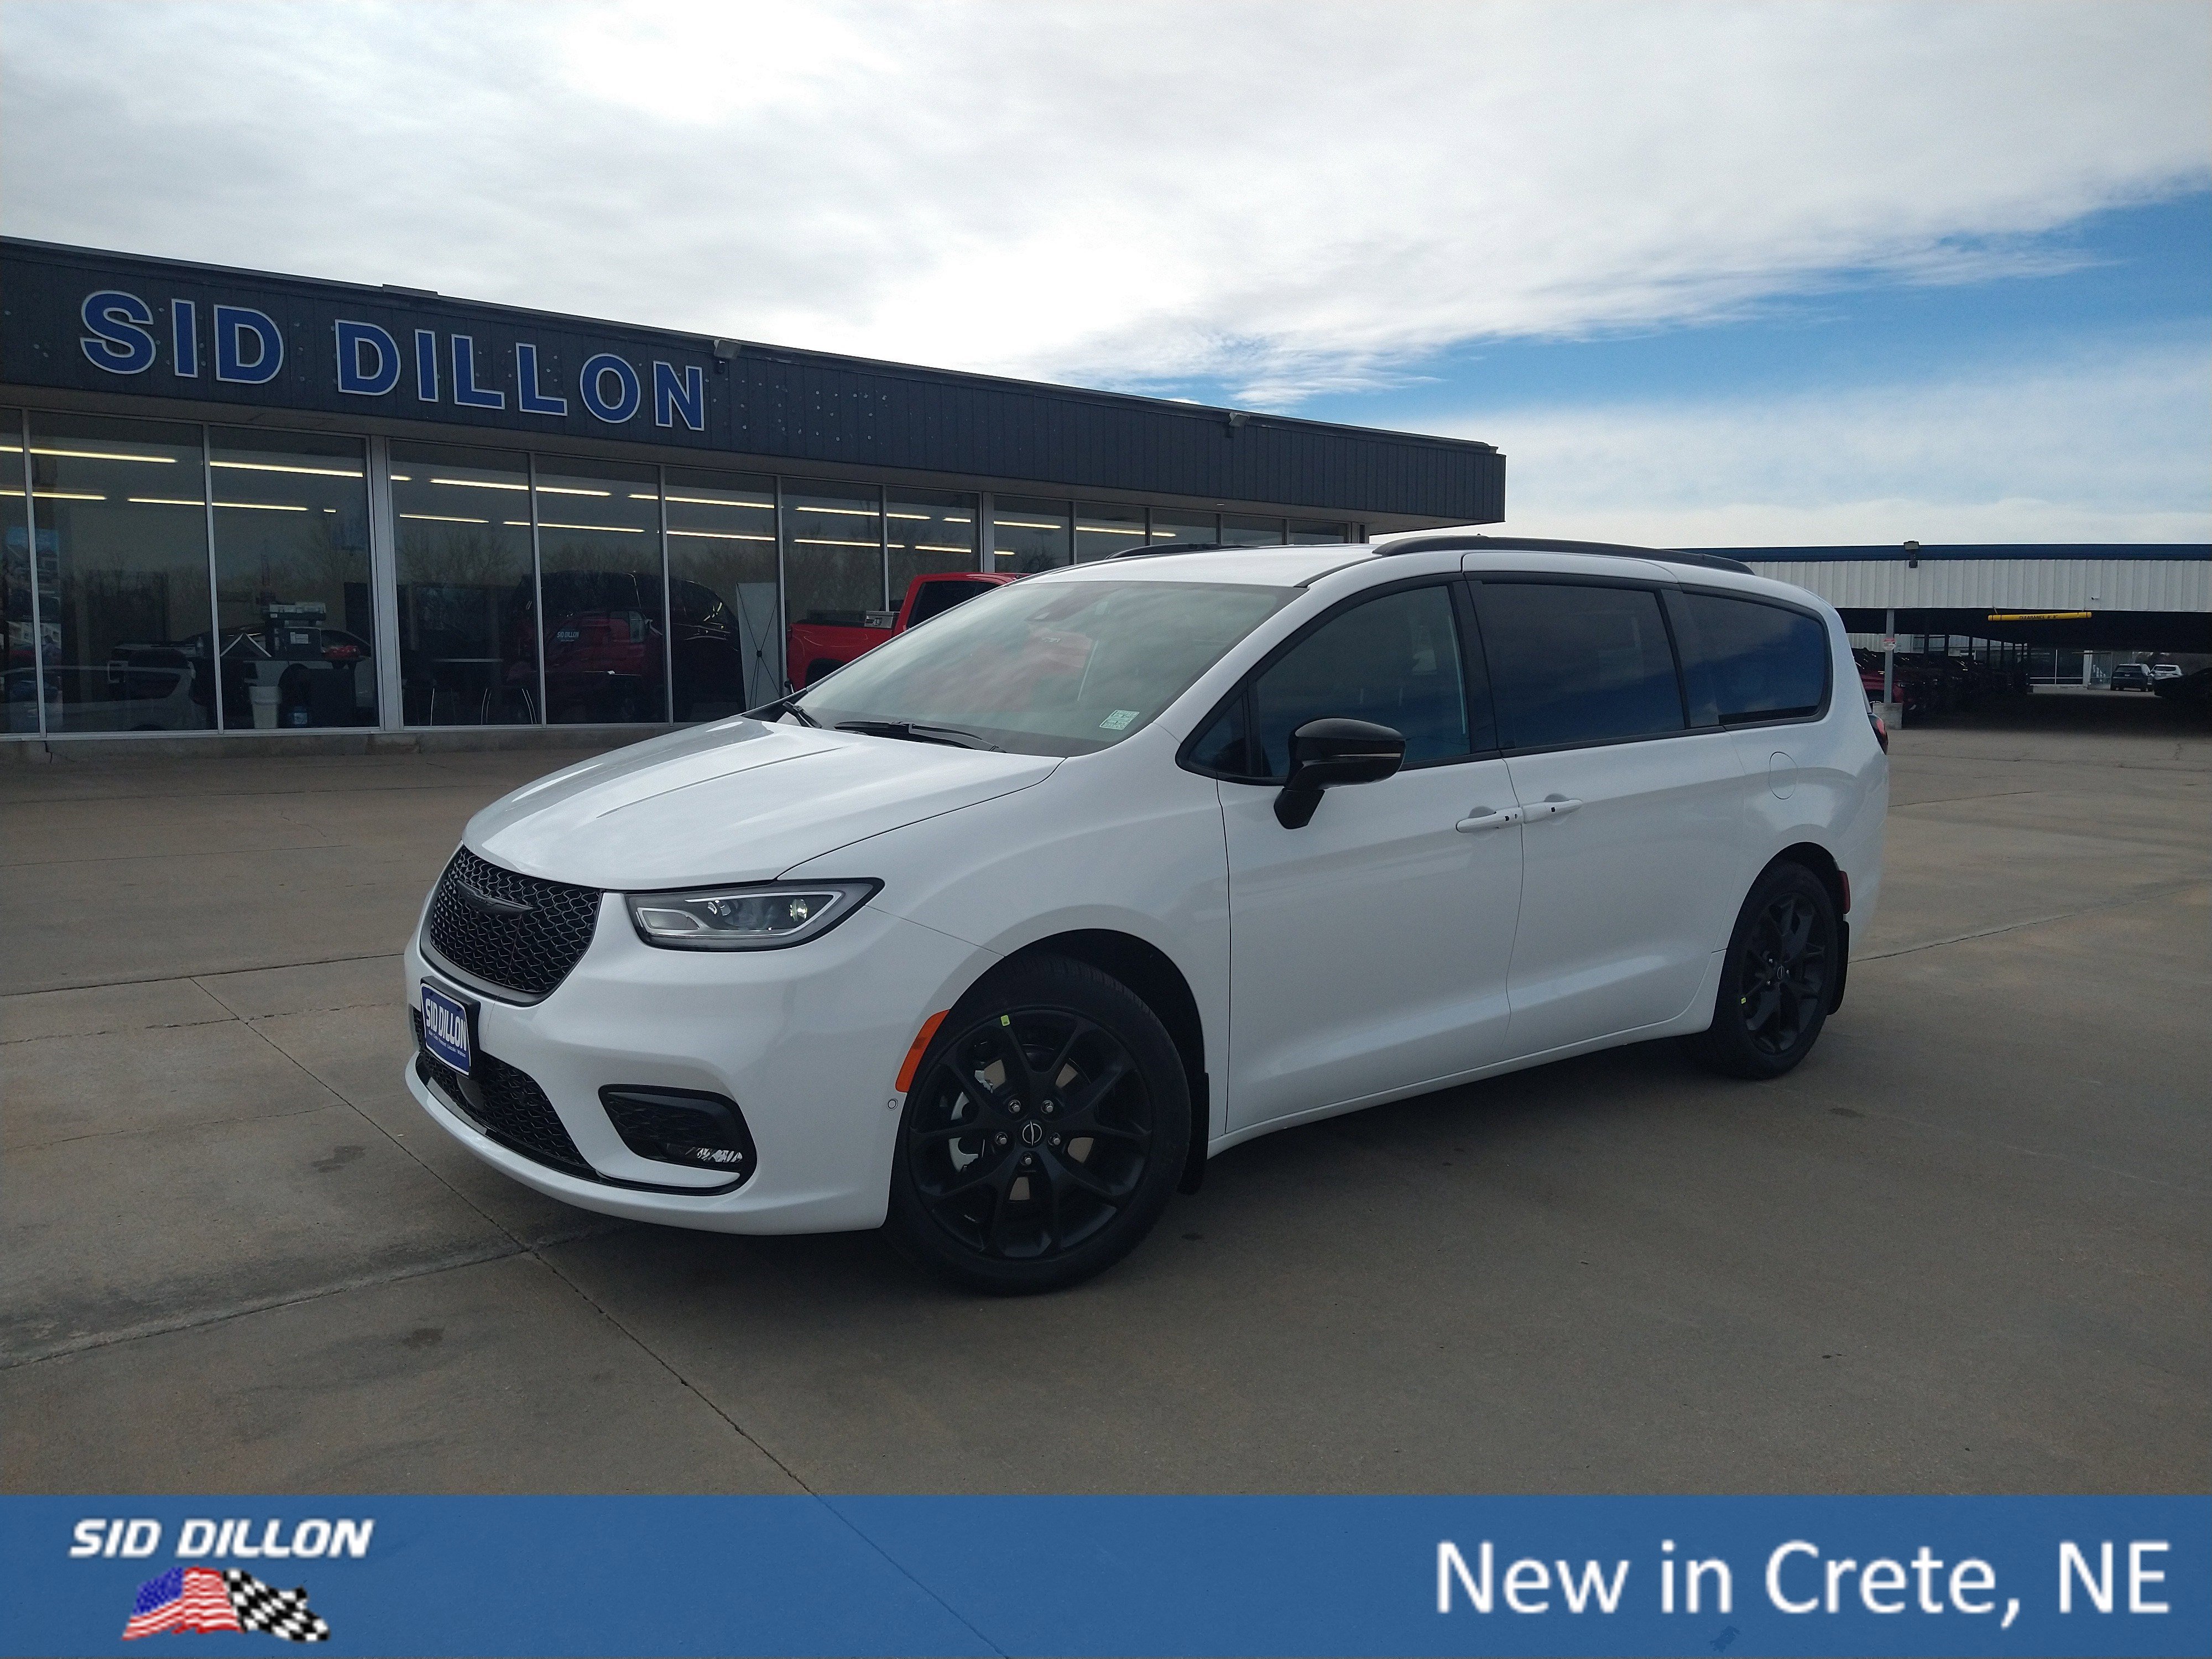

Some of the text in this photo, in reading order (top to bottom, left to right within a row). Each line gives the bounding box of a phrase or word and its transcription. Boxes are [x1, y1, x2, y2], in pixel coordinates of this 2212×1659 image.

[80, 290, 705, 431] SID DILLON
[425, 998, 438, 1032] SID
[438, 1005, 467, 1051] DILLON
